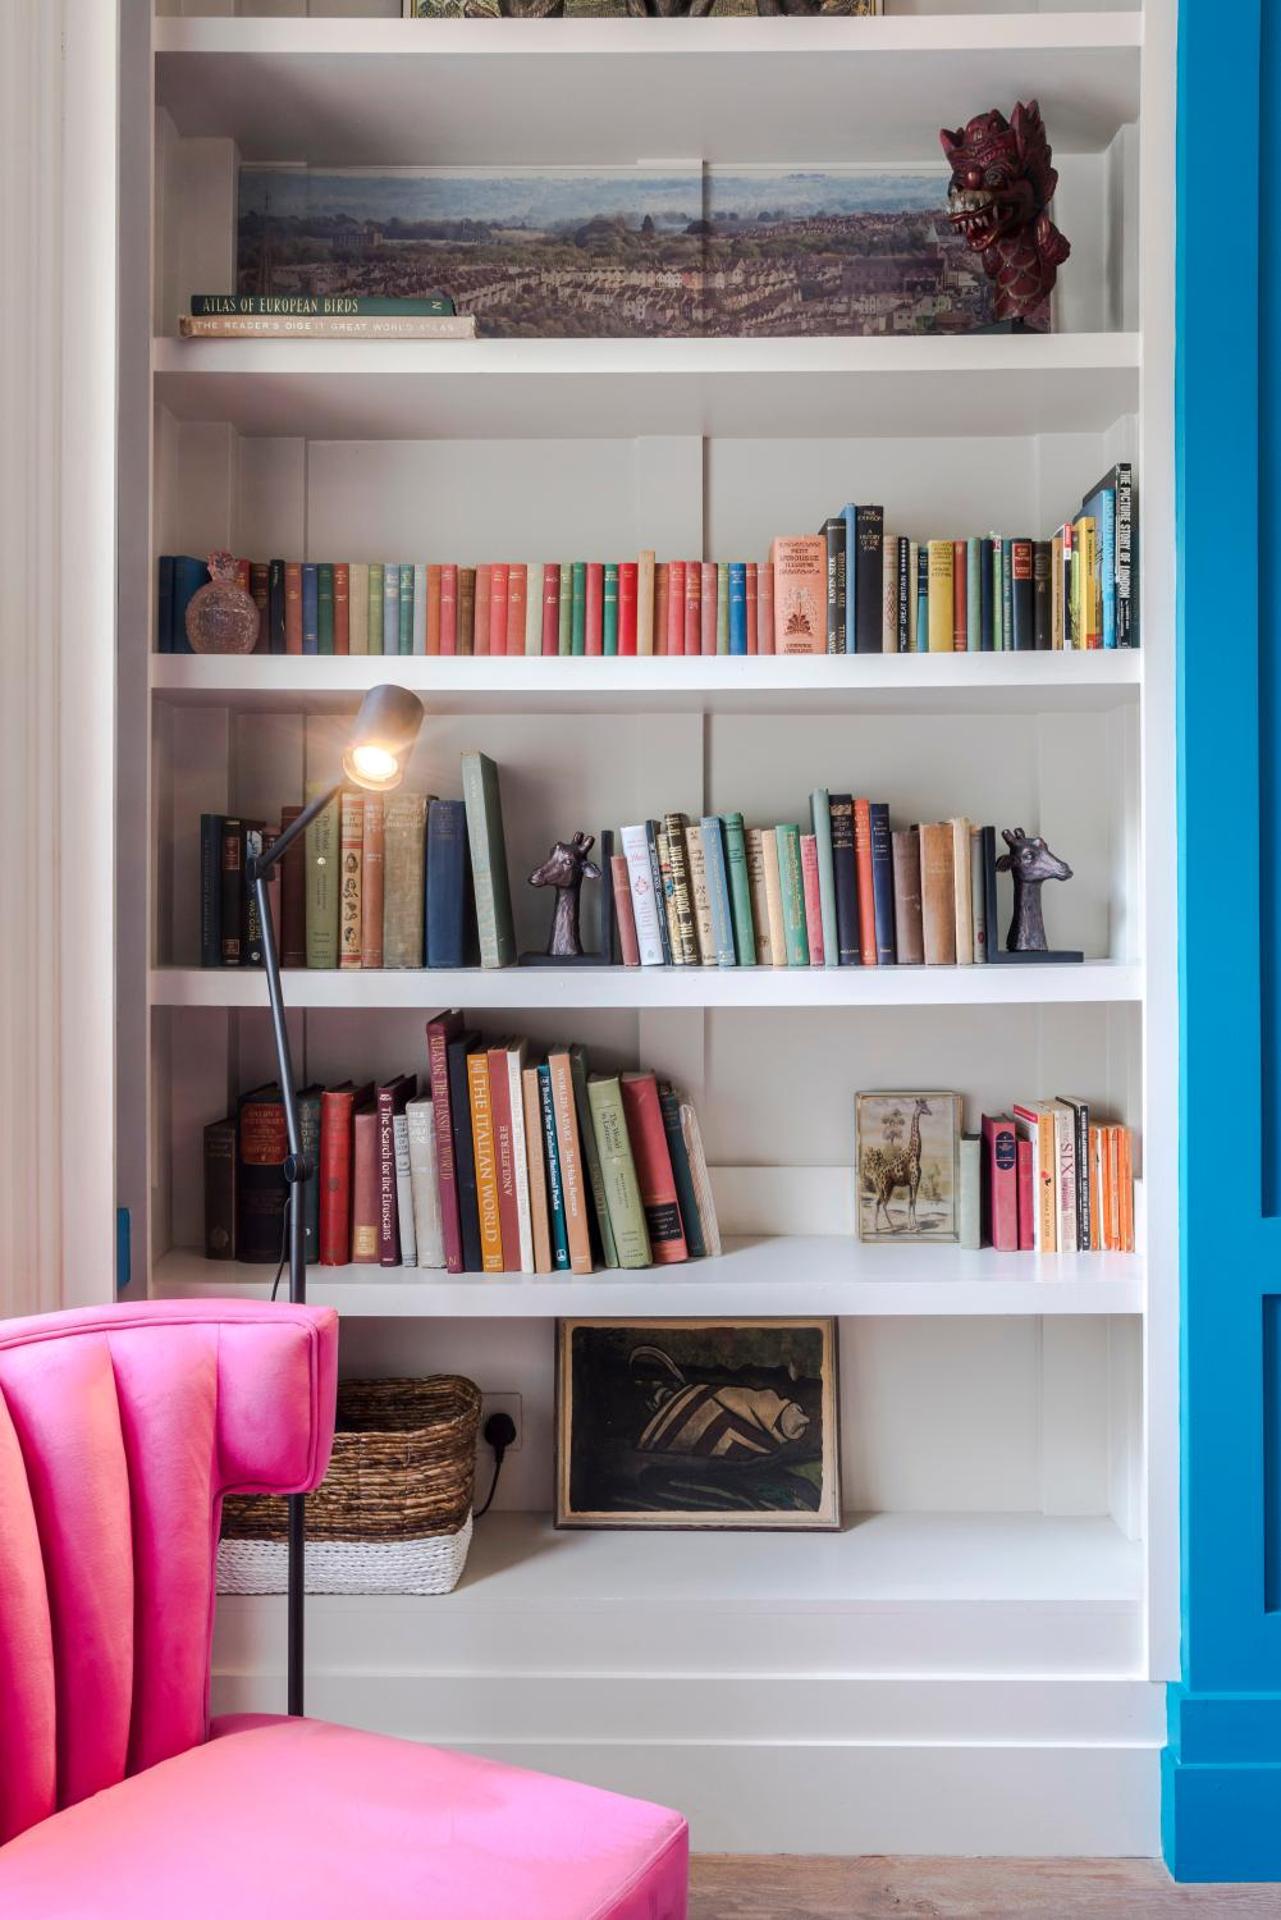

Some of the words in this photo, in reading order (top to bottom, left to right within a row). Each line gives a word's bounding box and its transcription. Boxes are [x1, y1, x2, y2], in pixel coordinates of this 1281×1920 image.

[203, 298, 236, 312] ATLAS
[240, 299, 254, 312] OF
[260, 299, 318, 312] EUROPEAN
[324, 299, 358, 312] BIRDS
[1119, 470, 1131, 485] THE
[1119, 487, 1131, 522] PICTURE
[1119, 524, 1131, 550] STORY
[1119, 552, 1131, 563] OF
[1119, 565, 1131, 598] LONDON
[669, 845, 684, 877] AFFAIR
[679, 920, 693, 938] THE
[433, 1080, 447, 1096] THE
[472, 1077, 488, 1108] THE
[381, 1106, 390, 1124] The
[380, 1127, 392, 1158] Search
[473, 1113, 494, 1178] ITALIAN
[382, 1161, 392, 1174] for
[438, 1146, 454, 1179] WORLD
[382, 1177, 391, 1191] the
[381, 1193, 391, 1240] Etruscans
[479, 1184, 499, 1242] WORLD
